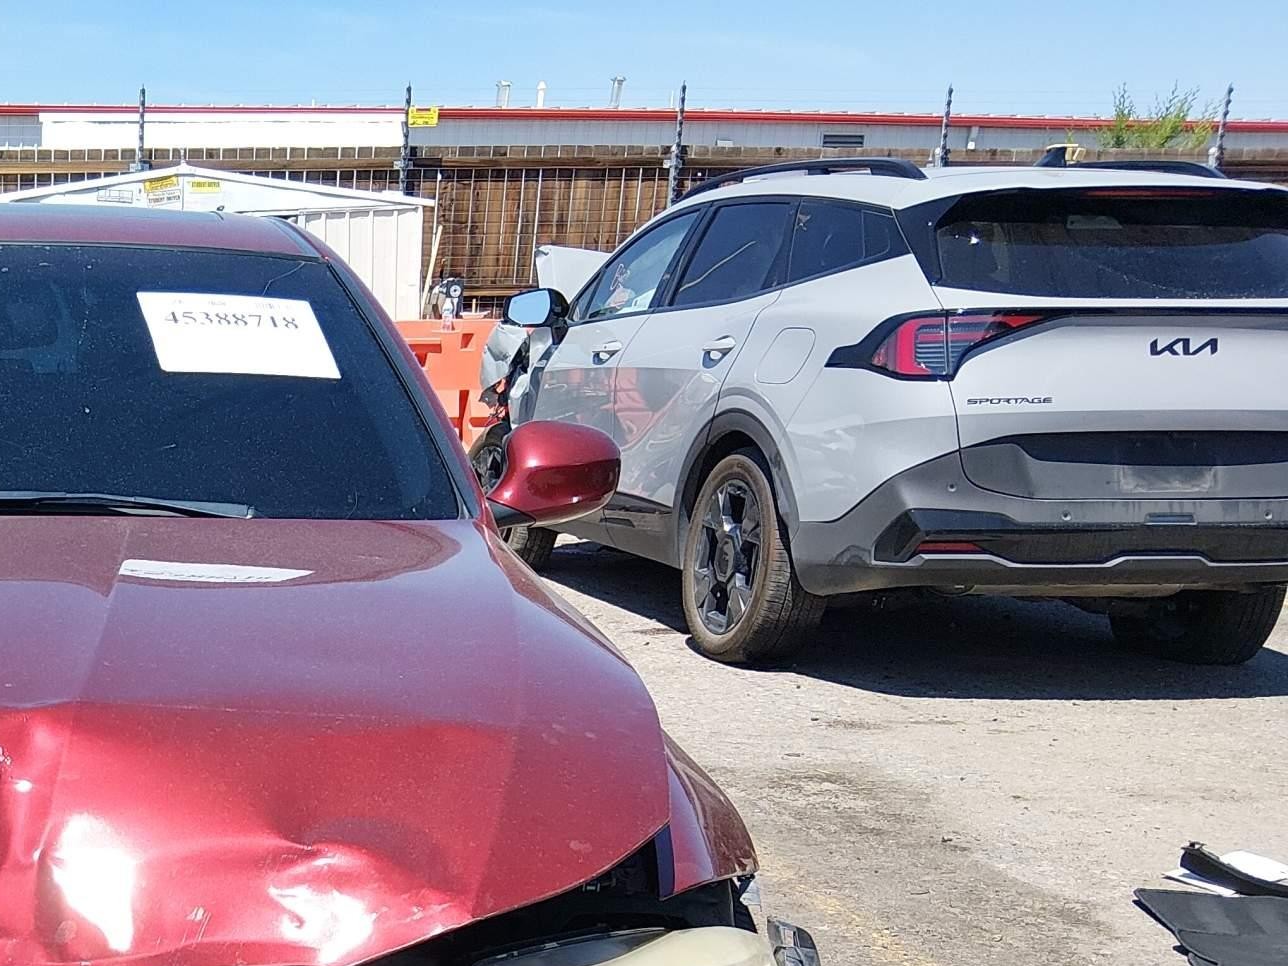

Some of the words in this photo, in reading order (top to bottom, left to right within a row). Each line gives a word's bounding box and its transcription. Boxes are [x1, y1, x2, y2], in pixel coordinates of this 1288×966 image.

[165, 311, 299, 329] 45388718
[1149, 337, 1219, 356] KIA
[967, 396, 1053, 406] SPORTAGE
